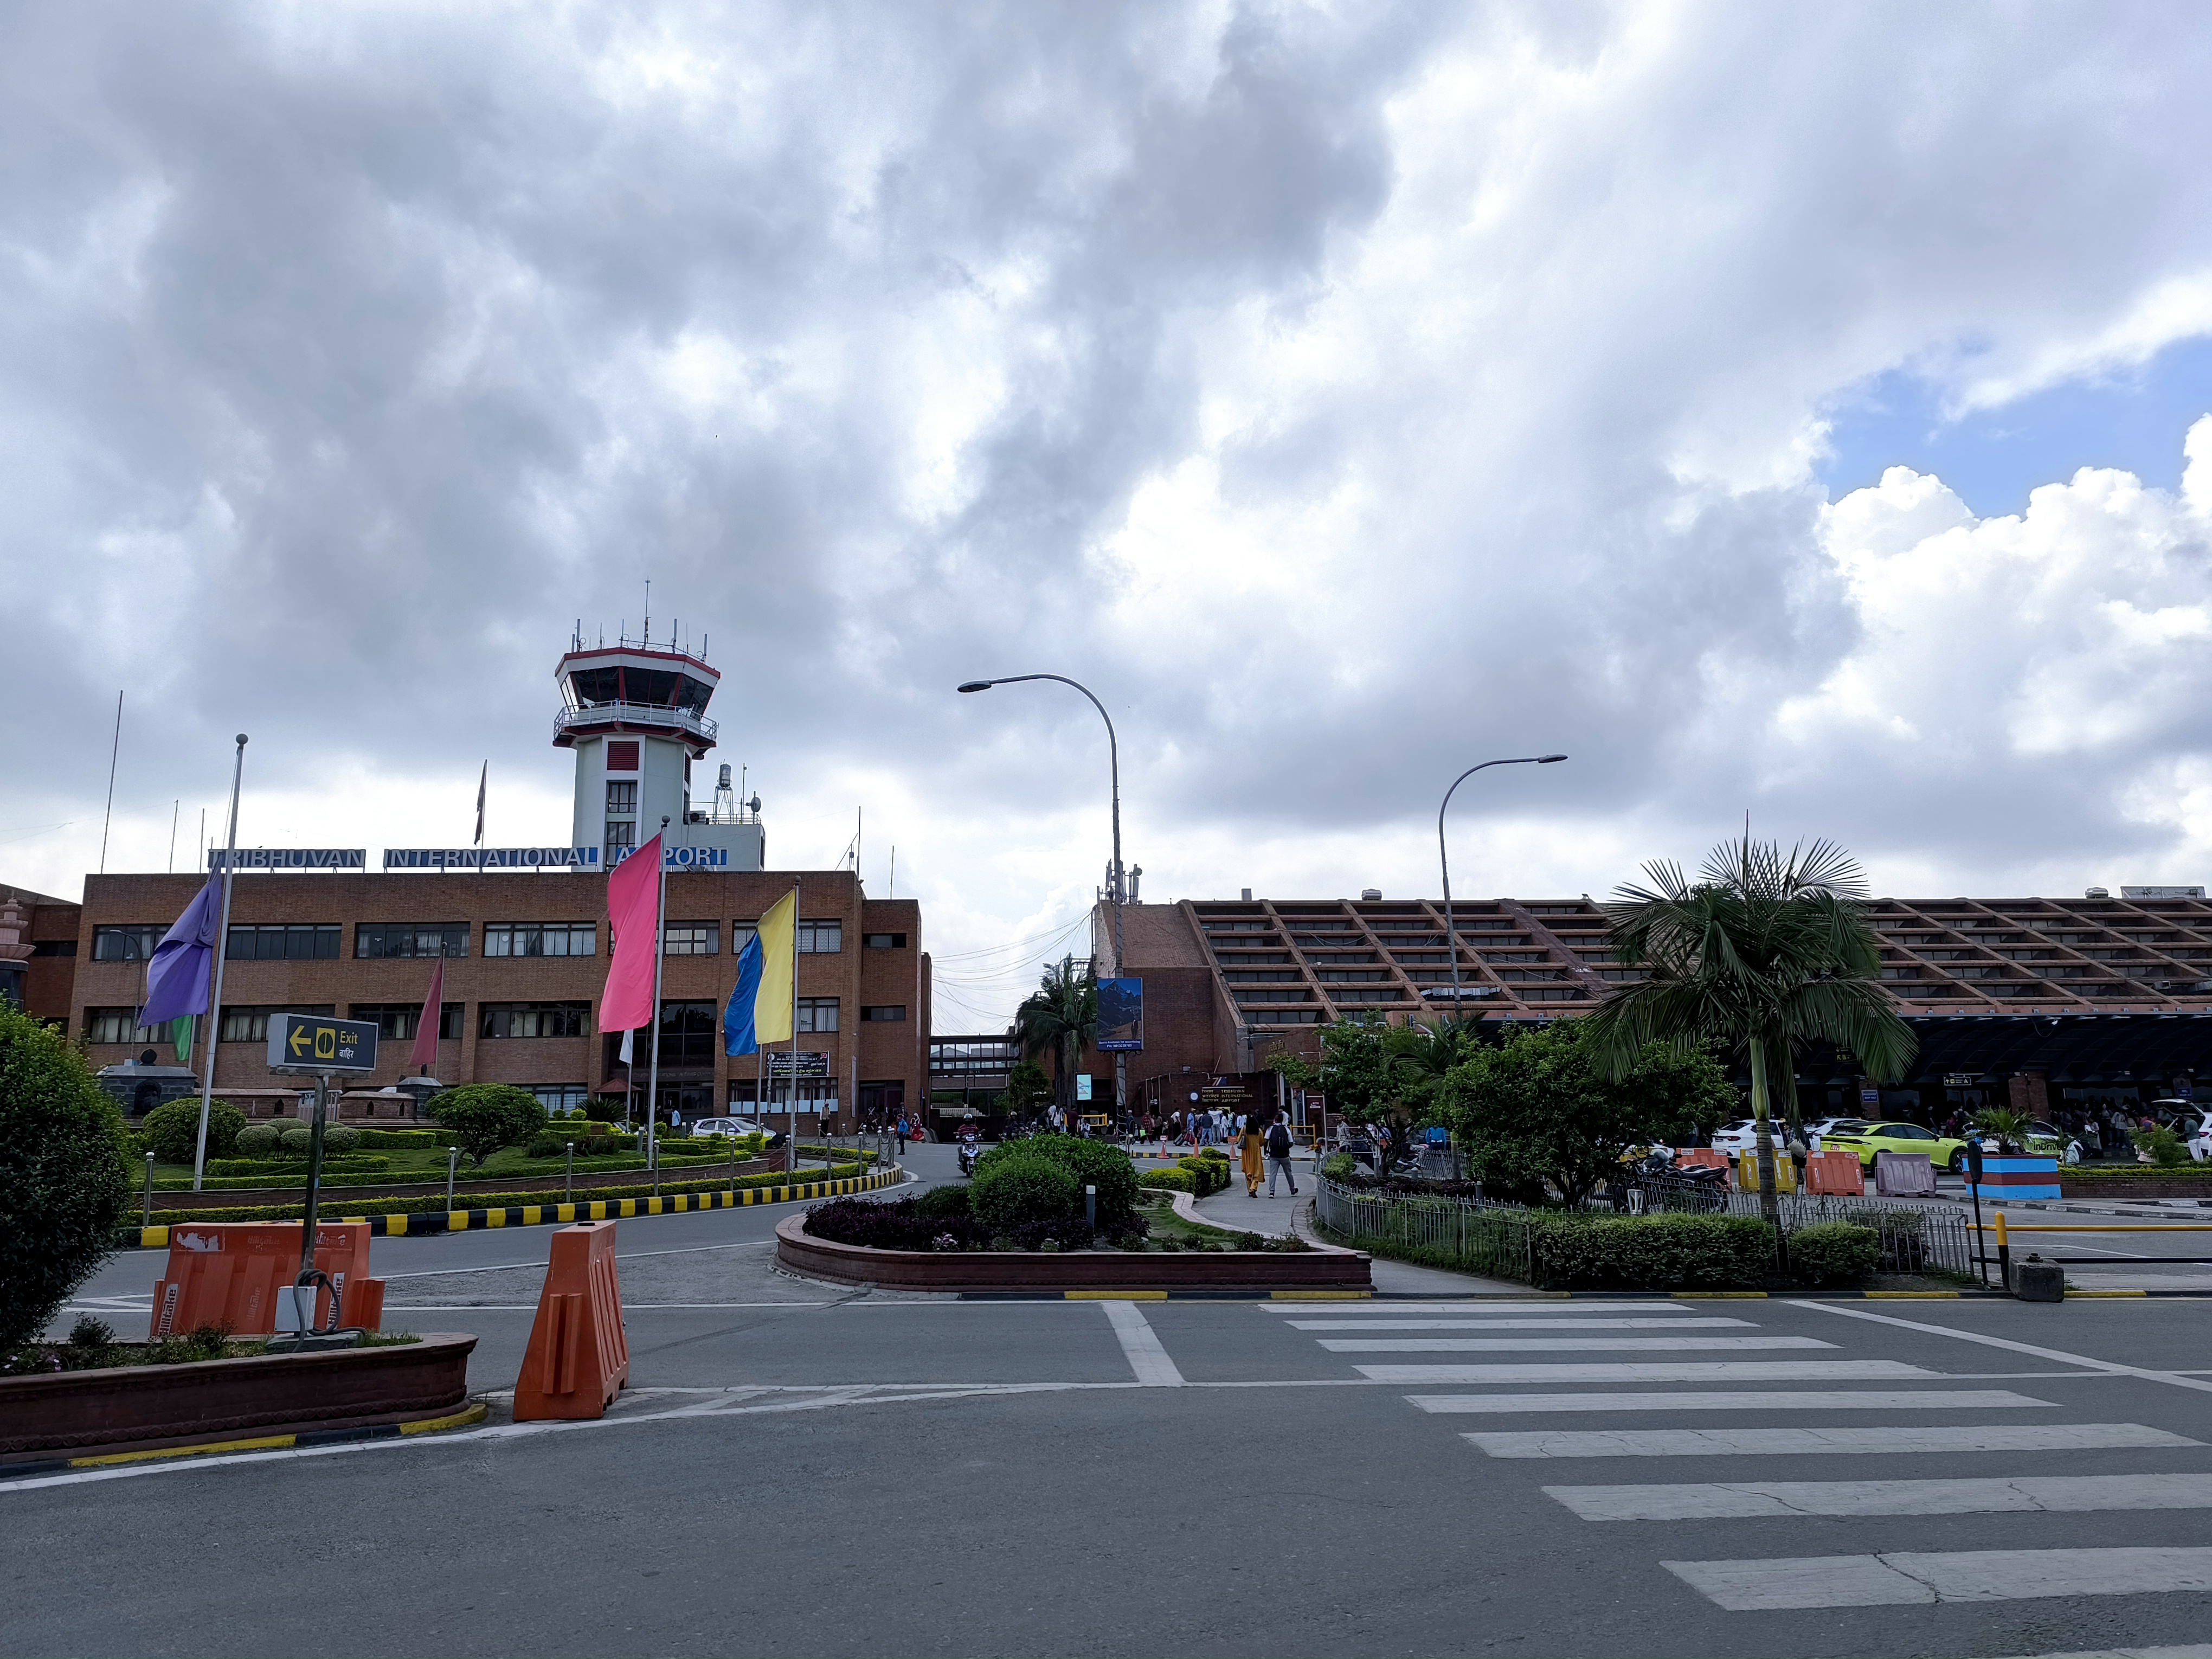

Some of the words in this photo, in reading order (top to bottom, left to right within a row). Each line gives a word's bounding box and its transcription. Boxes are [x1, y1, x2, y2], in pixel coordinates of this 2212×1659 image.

[208, 849, 365, 867] TRIBHUVAN
[383, 847, 597, 866] INTERNATIONAL
[615, 846, 727, 866] APORT
[340, 1031, 358, 1044] Exit
[339, 1047, 354, 1059] वाहिर
[328, 1277, 343, 1324] Hilltke
